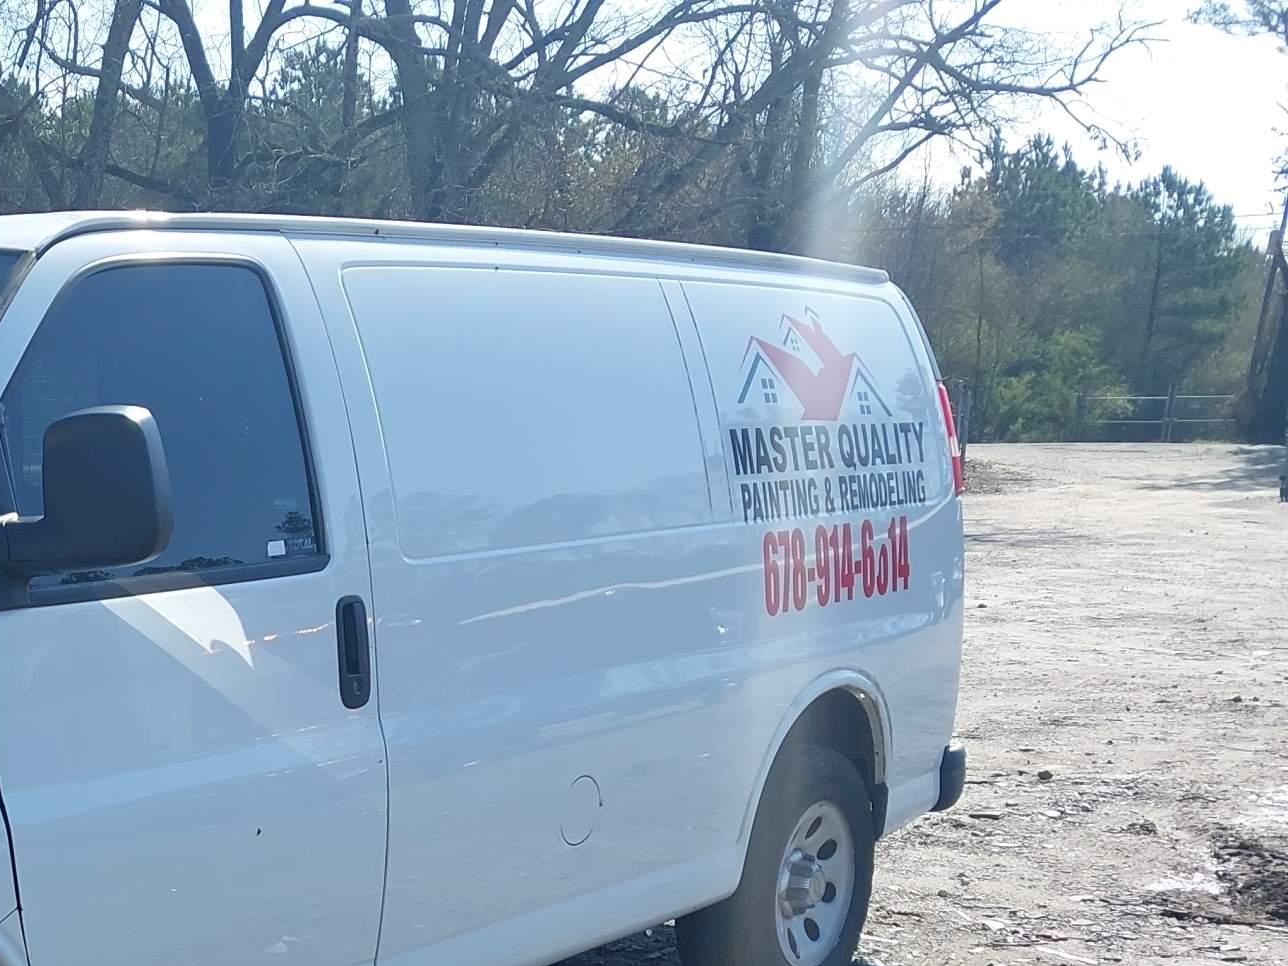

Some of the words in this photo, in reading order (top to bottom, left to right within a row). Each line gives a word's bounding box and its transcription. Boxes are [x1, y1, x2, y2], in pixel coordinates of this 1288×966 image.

[729, 425, 834, 476] MASTER
[838, 423, 924, 470] QUALITY
[741, 478, 818, 521] PAINTING
[824, 478, 836, 513] &
[839, 470, 926, 512] REMODELING
